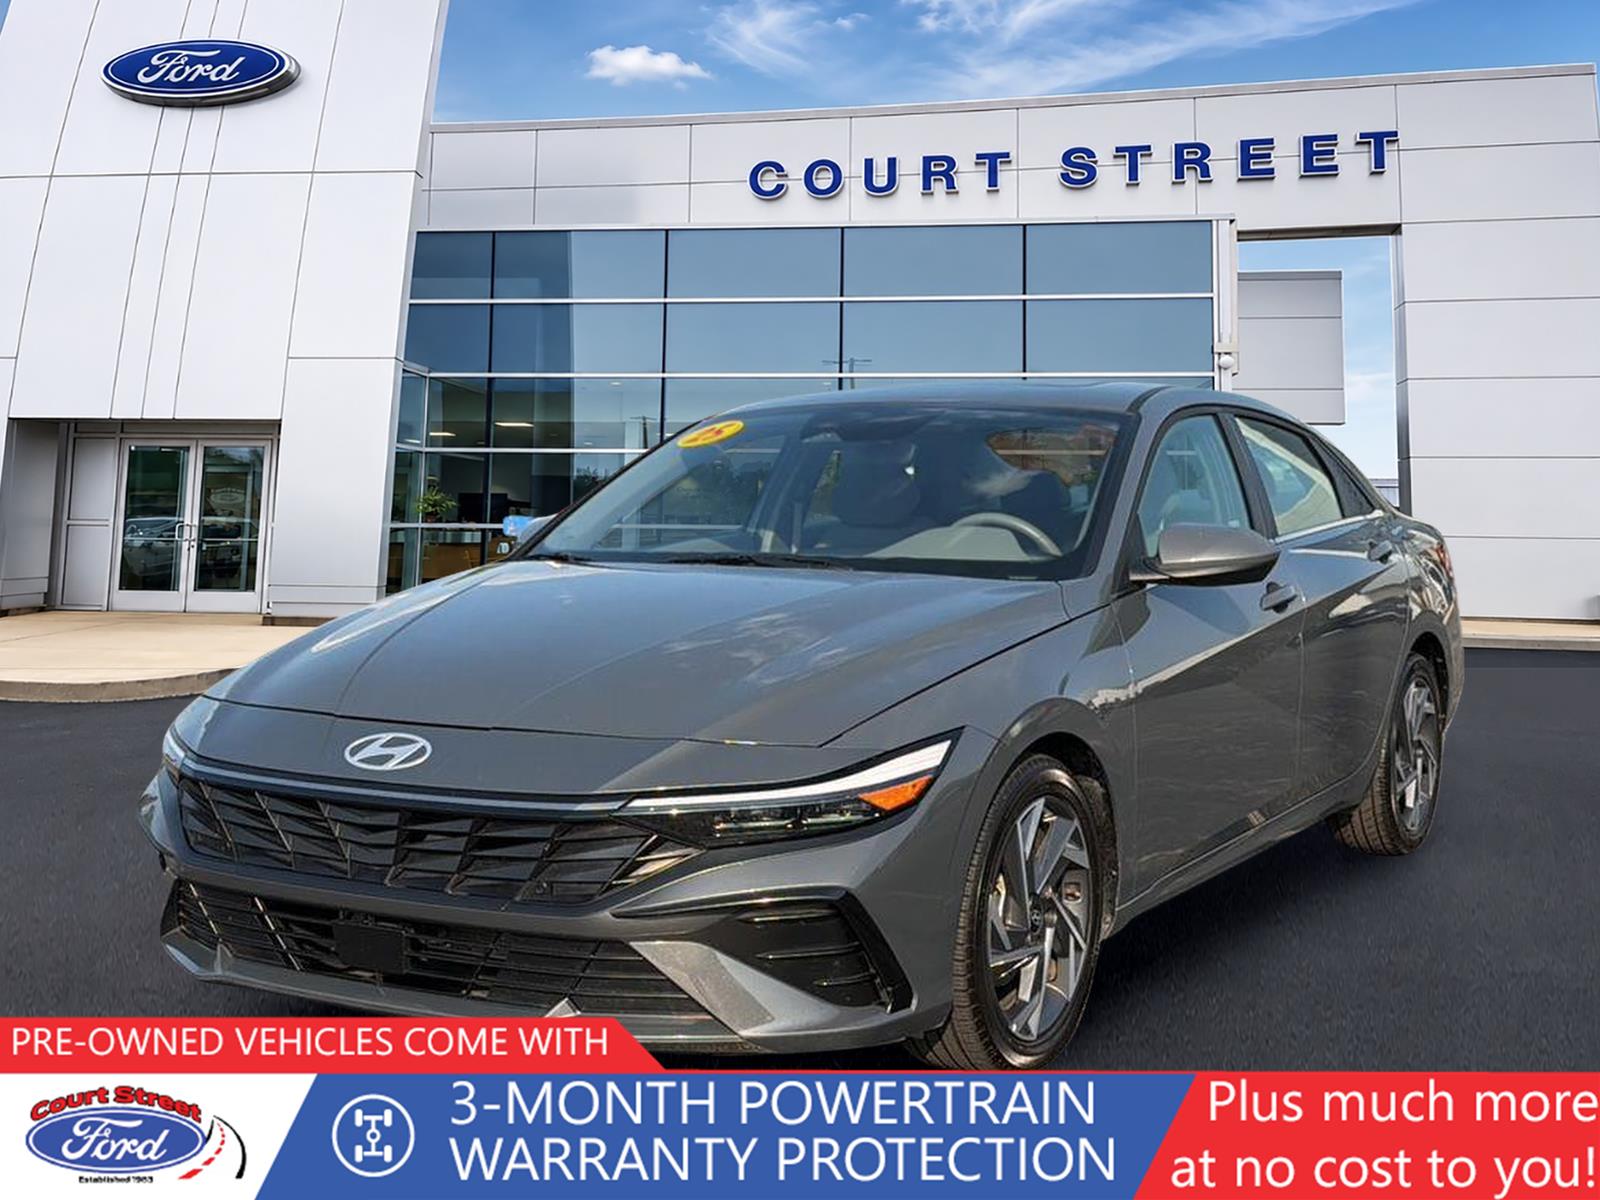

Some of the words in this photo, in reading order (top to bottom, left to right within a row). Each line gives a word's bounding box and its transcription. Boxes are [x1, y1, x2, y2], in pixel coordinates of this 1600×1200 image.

[136, 49, 245, 84] Ford
[748, 151, 1011, 200] COURT
[1059, 129, 1399, 188] STREET
